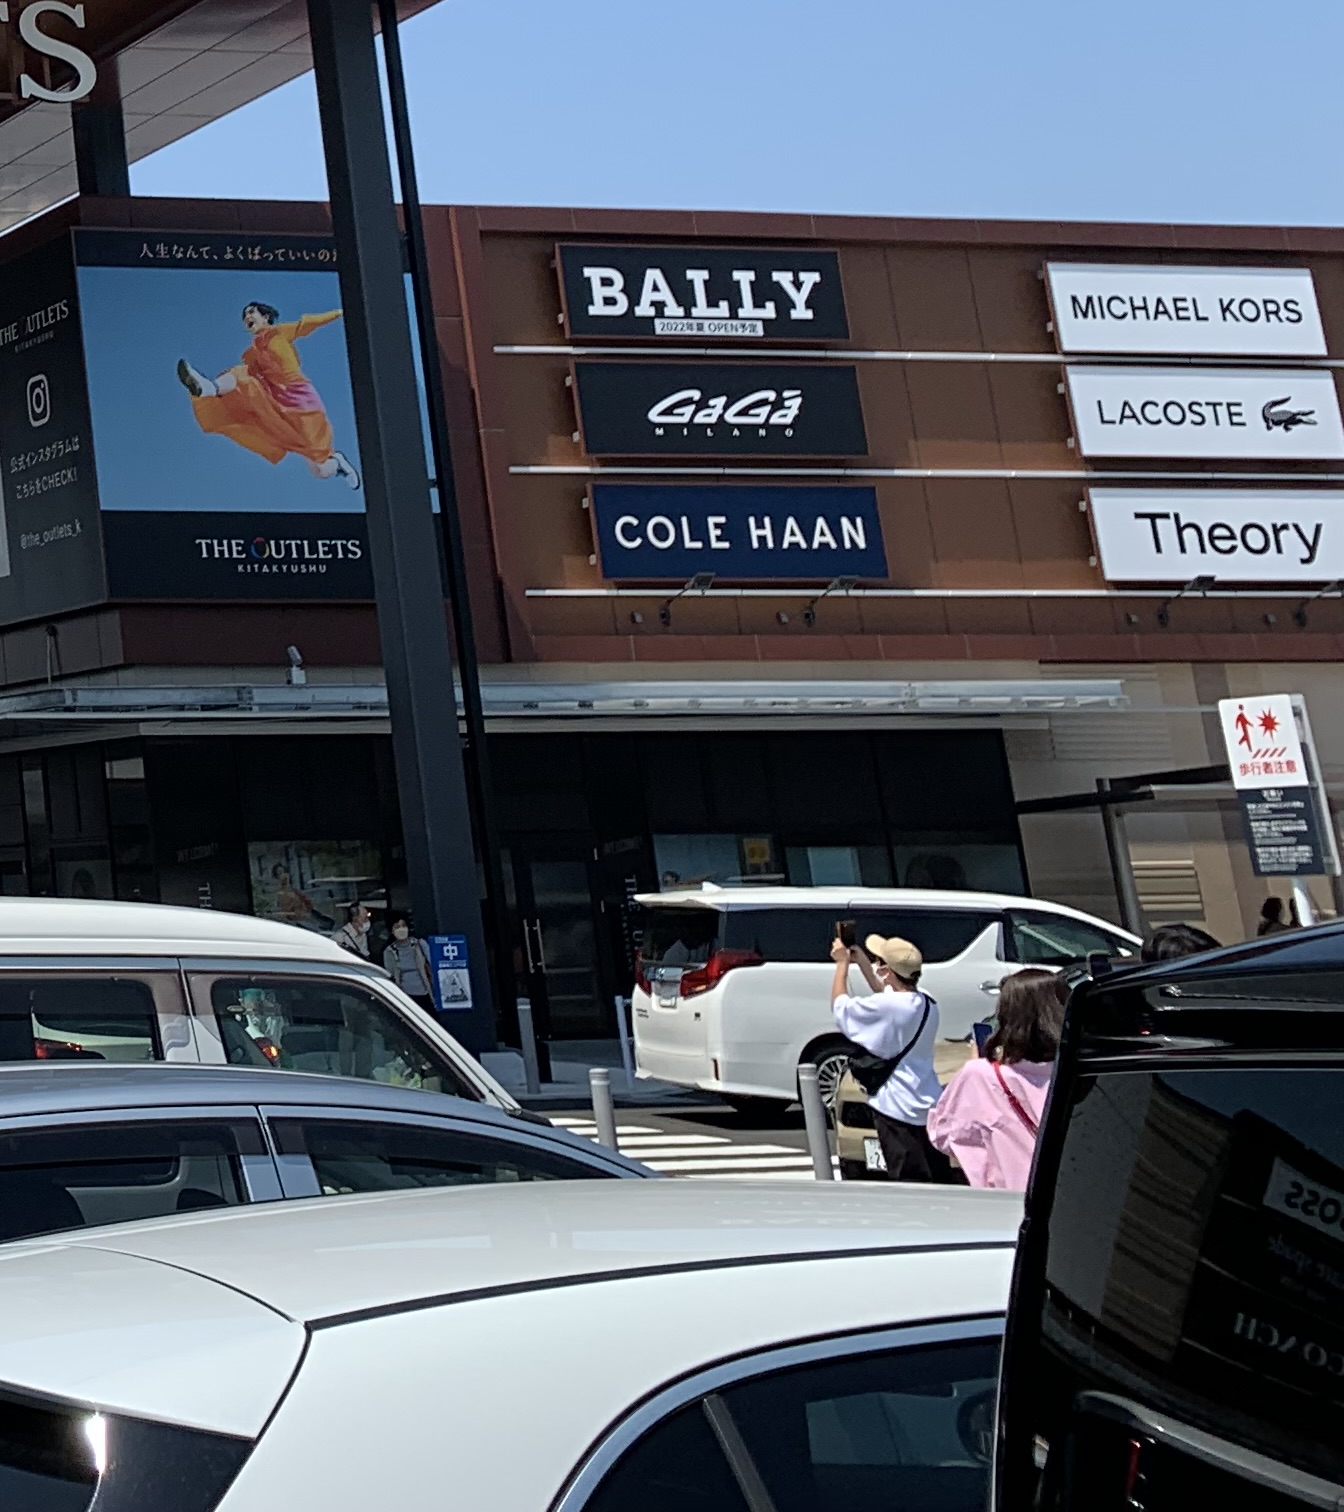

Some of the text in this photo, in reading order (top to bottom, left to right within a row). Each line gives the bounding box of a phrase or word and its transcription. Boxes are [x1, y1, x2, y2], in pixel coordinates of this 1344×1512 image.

[582, 266, 821, 321] BALLY
[1069, 294, 1303, 324] MICHAEL KORS
[1096, 399, 1247, 427] LACOSTE
[654, 426, 795, 438] MILANO
[9, 433, 81, 474] 公式インスタグラムは
[614, 514, 867, 551] COLE HAAN
[1133, 512, 1323, 566] Theory
[194, 536, 363, 560] THE OUTLETS
[237, 563, 328, 574] KITAKYUSHU
[1239, 759, 1297, 776] 歩行者注意
